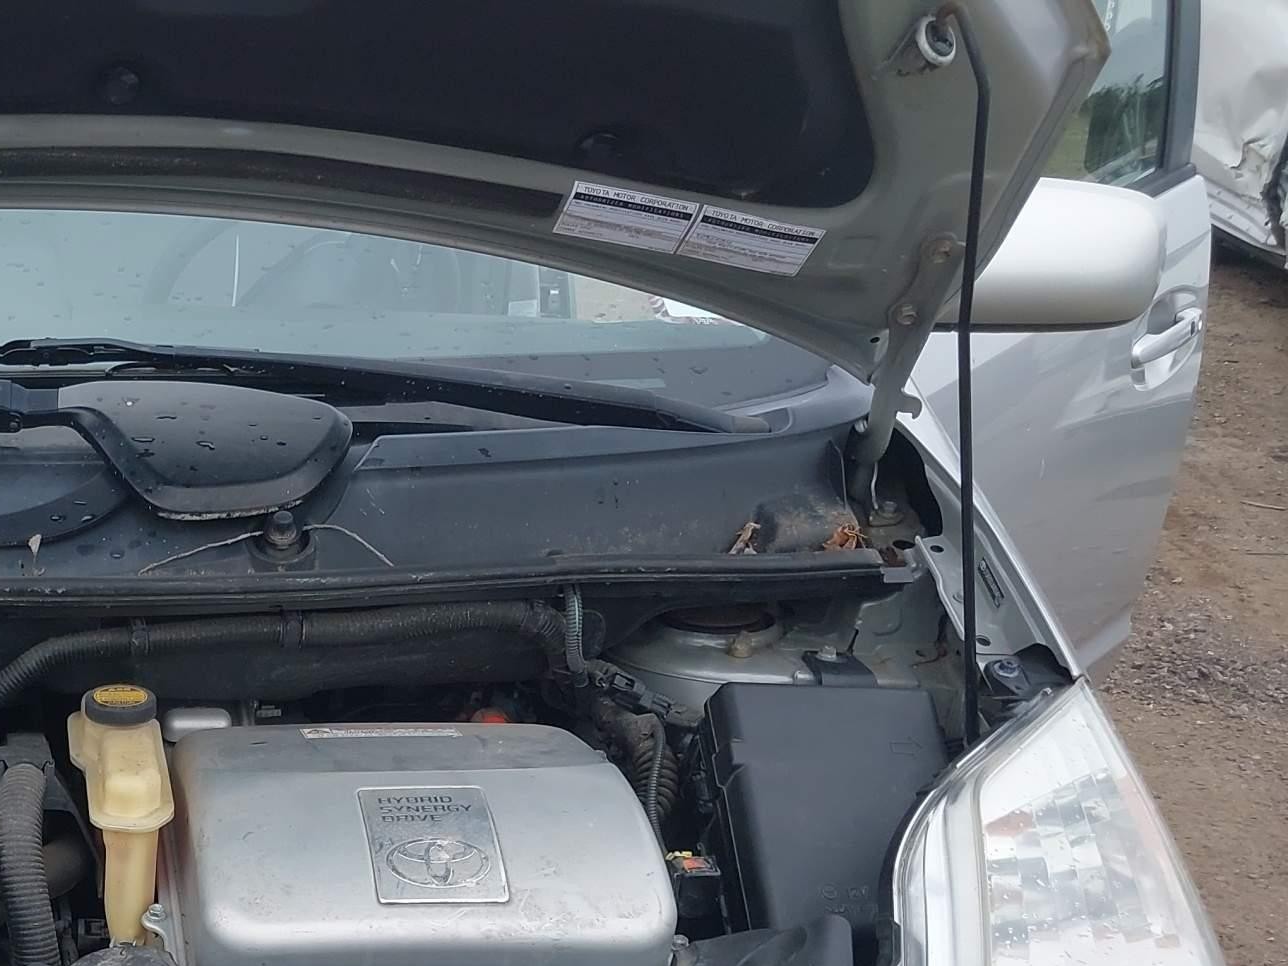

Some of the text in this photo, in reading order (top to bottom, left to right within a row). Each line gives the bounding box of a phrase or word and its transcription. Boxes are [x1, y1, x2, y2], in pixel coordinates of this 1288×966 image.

[583, 186, 690, 212] TOYOTA MOTOR CORPORATION
[377, 795, 453, 804] HYBRID
[379, 804, 472, 814] SYNERGY
[381, 814, 443, 823] DRIVE
